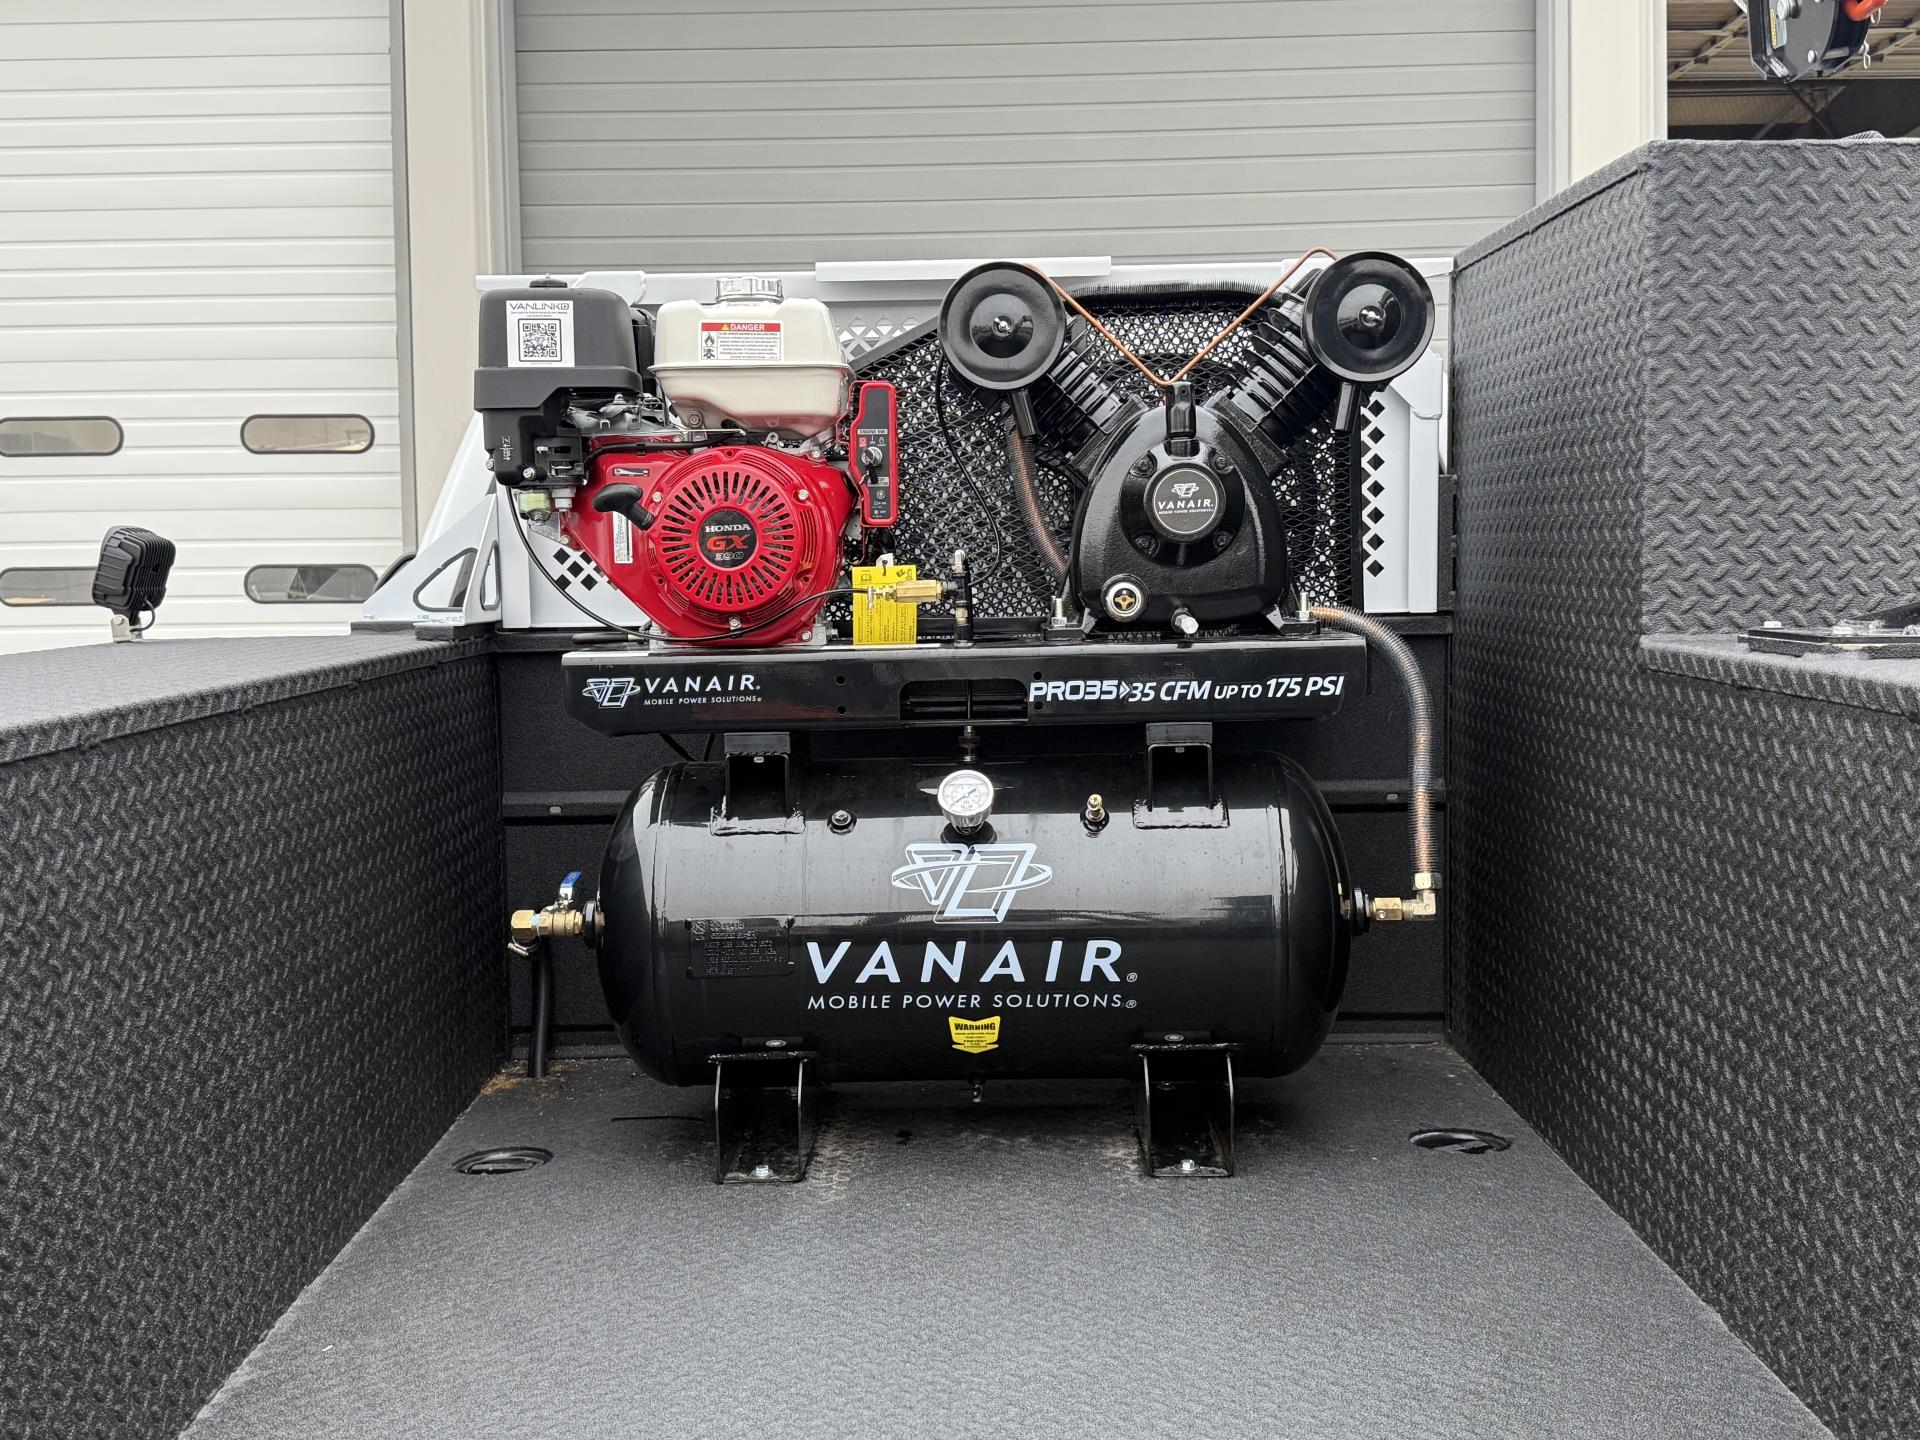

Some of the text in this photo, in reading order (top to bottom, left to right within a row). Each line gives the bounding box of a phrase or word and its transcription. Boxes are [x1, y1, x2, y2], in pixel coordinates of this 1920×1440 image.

[730, 323, 766, 331] DANGER
[705, 524, 751, 532] HONDA
[707, 534, 750, 551] GX
[714, 552, 744, 561] 390
[1029, 675, 1345, 702] PRO35 35 CFM UP TO 175 PSI
[643, 698, 674, 706] MOBILE
[678, 696, 707, 704] POWER
[807, 995, 891, 1009] MOBILE
[902, 994, 981, 1009] POWER
[954, 1022, 996, 1031] WARNING
